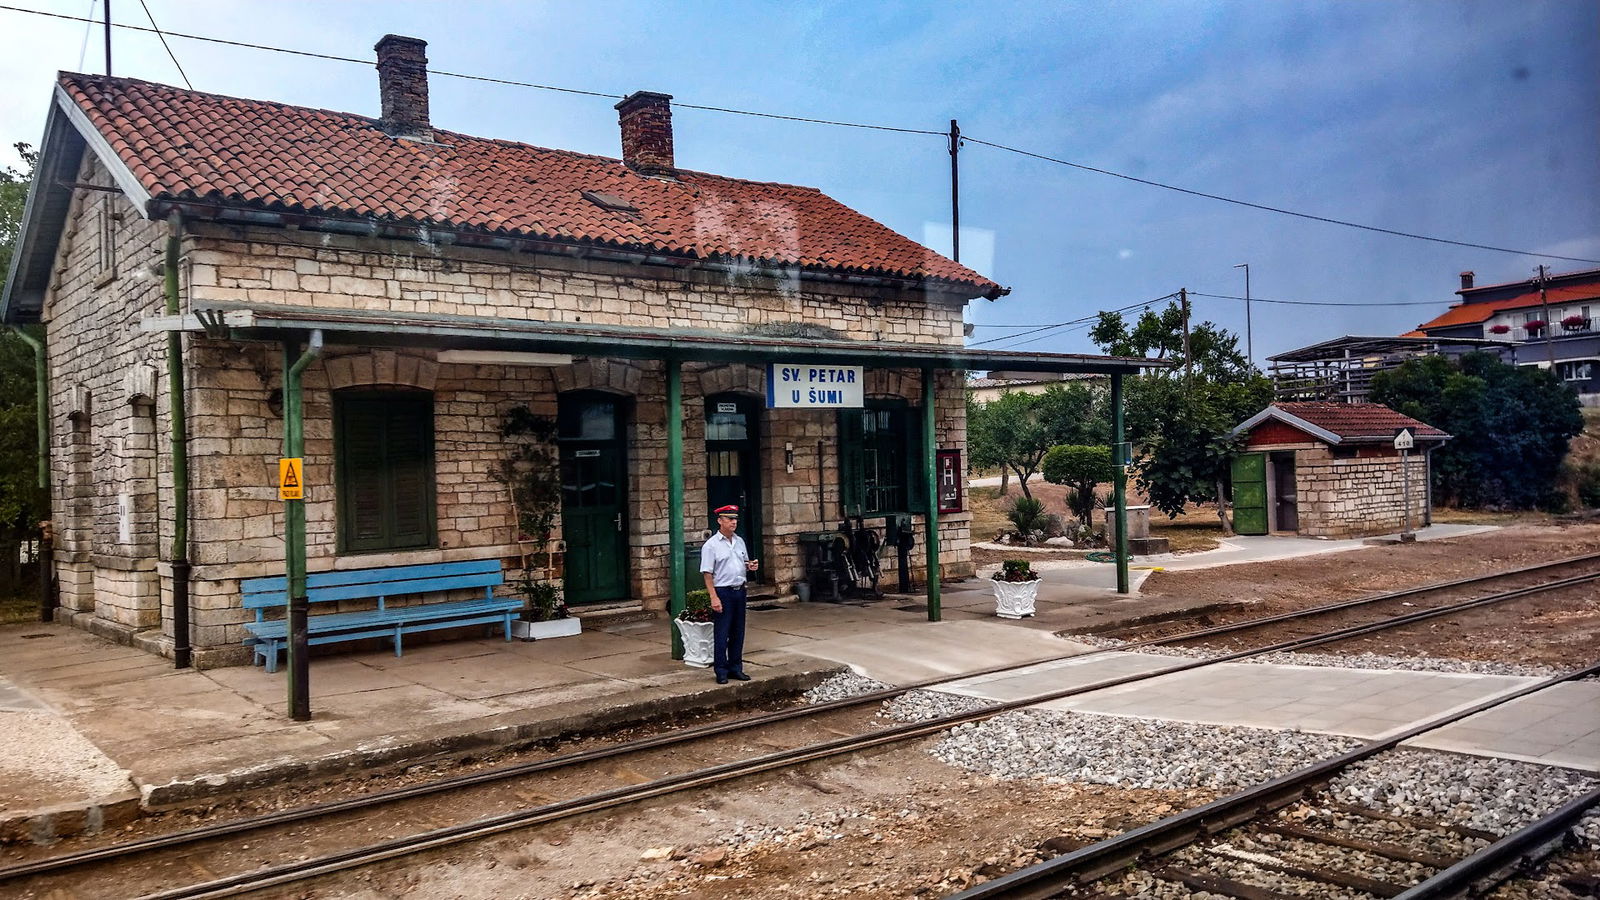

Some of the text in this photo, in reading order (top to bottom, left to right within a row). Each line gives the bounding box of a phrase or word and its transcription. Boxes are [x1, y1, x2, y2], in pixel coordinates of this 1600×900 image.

[782, 368, 855, 383] SV. PETAR
[792, 387, 843, 404] U ŠUMI
